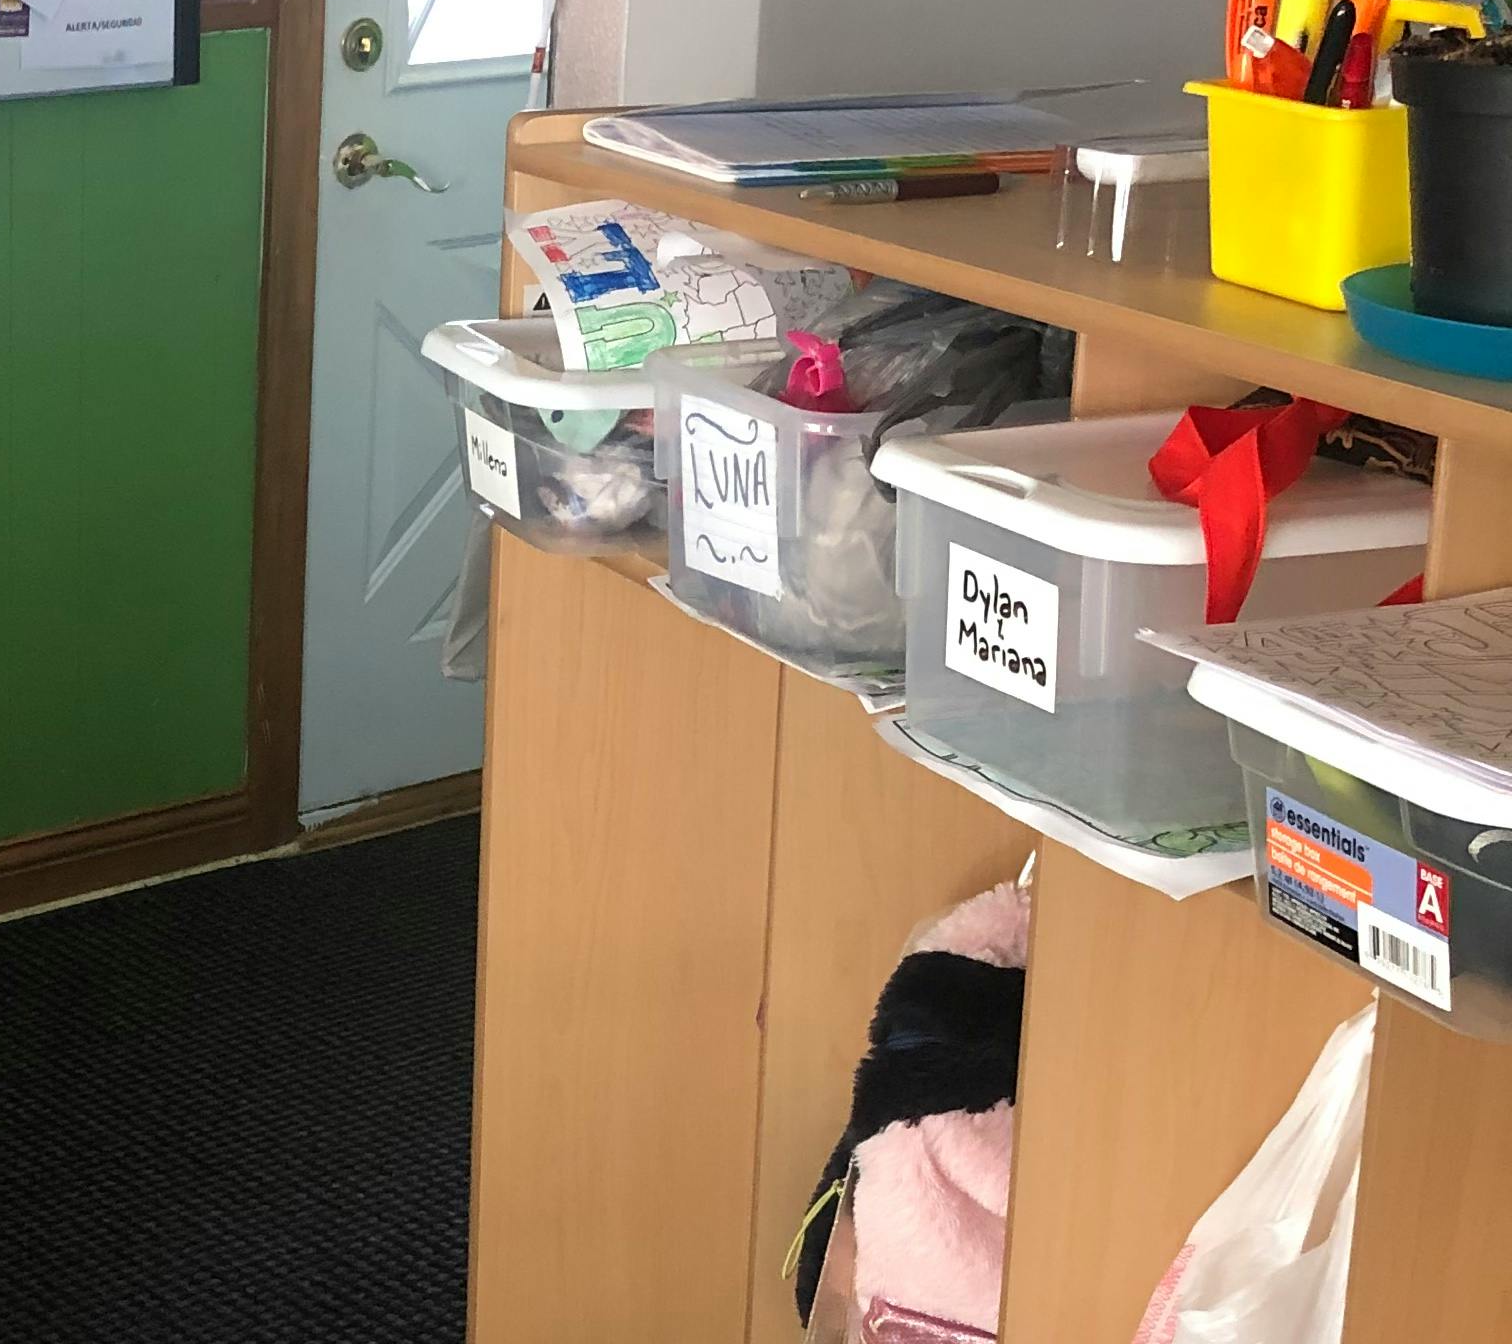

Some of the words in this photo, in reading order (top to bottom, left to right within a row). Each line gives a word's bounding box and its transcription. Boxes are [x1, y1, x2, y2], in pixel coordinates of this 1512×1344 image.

[688, 442, 771, 510] LUNA
[962, 569, 1029, 624] Dylan
[957, 618, 1047, 688] Mariana
[1287, 808, 1366, 863] essentials
[1303, 843, 1321, 863] box
[1417, 883, 1445, 924] A
